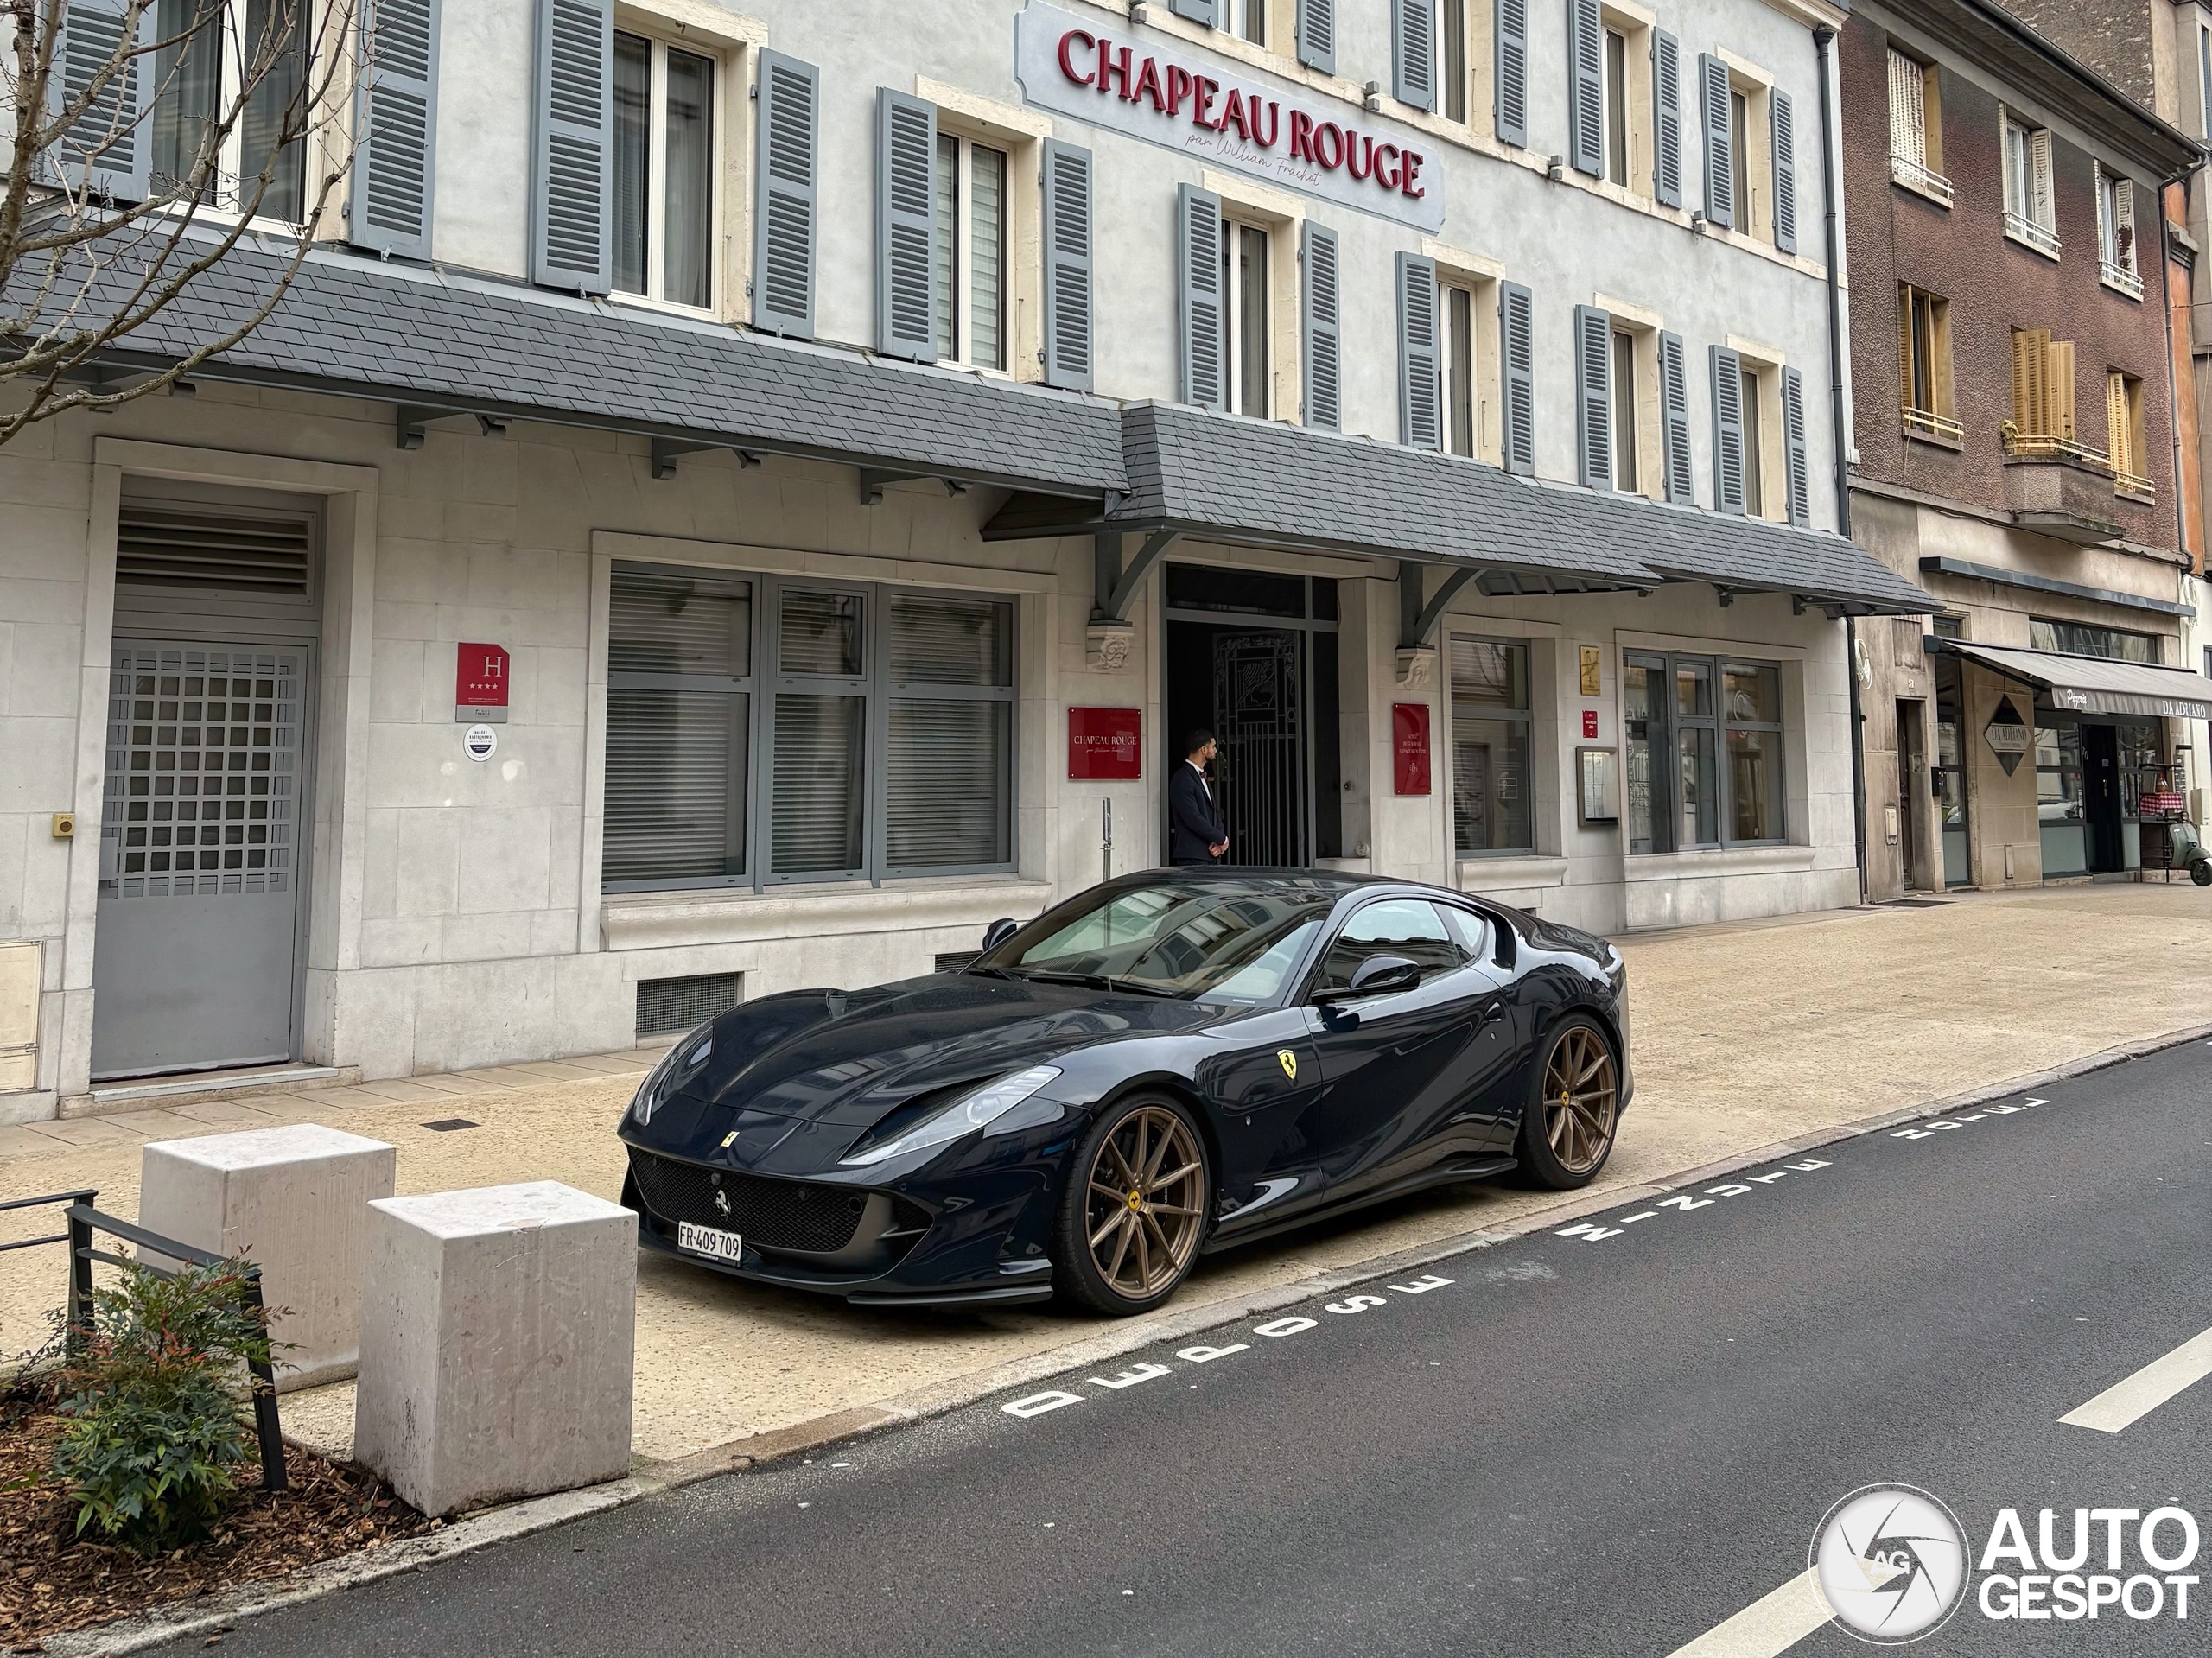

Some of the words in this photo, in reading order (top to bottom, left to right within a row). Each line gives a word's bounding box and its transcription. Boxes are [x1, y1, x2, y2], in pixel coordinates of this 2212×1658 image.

[1058, 29, 1280, 148] CHAPEAU
[1289, 109, 1425, 199] ROUGE
[1185, 134, 1212, 147] par
[1216, 137, 1273, 168] William
[1276, 157, 1322, 186] Frachot
[483, 656, 503, 677] H
[2162, 700, 2174, 715] DA
[2175, 702, 2206, 718] ADRIANO
[1073, 735, 1110, 745] CHAPEAU
[1111, 736, 1137, 746] ROUGE
[1992, 727, 2001, 740] DA
[1000, 1274, 1456, 1419] DEPOSE
[1554, 1158, 1833, 1242] MINUTE
[1890, 1097, 2050, 1140] HOTEL
